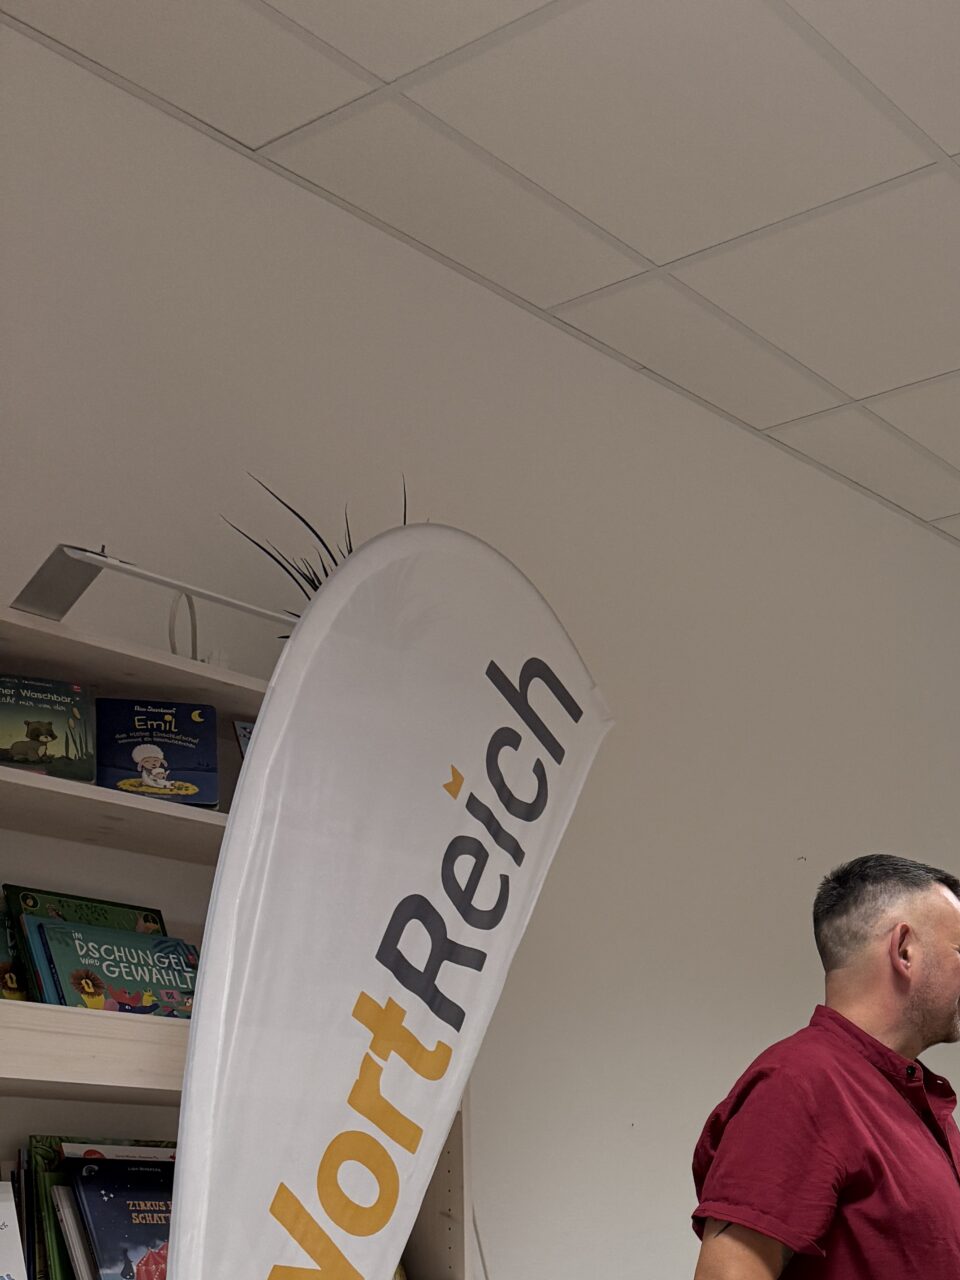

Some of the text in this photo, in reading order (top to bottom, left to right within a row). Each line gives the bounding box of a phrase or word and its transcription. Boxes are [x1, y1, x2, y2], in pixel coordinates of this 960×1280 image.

[134, 714, 178, 732] Emil
[74, 940, 193, 972] DSCHUNGEL
[102, 960, 195, 989] GEWÄHLT
[126, 1200, 166, 1211] ZIRKUS
